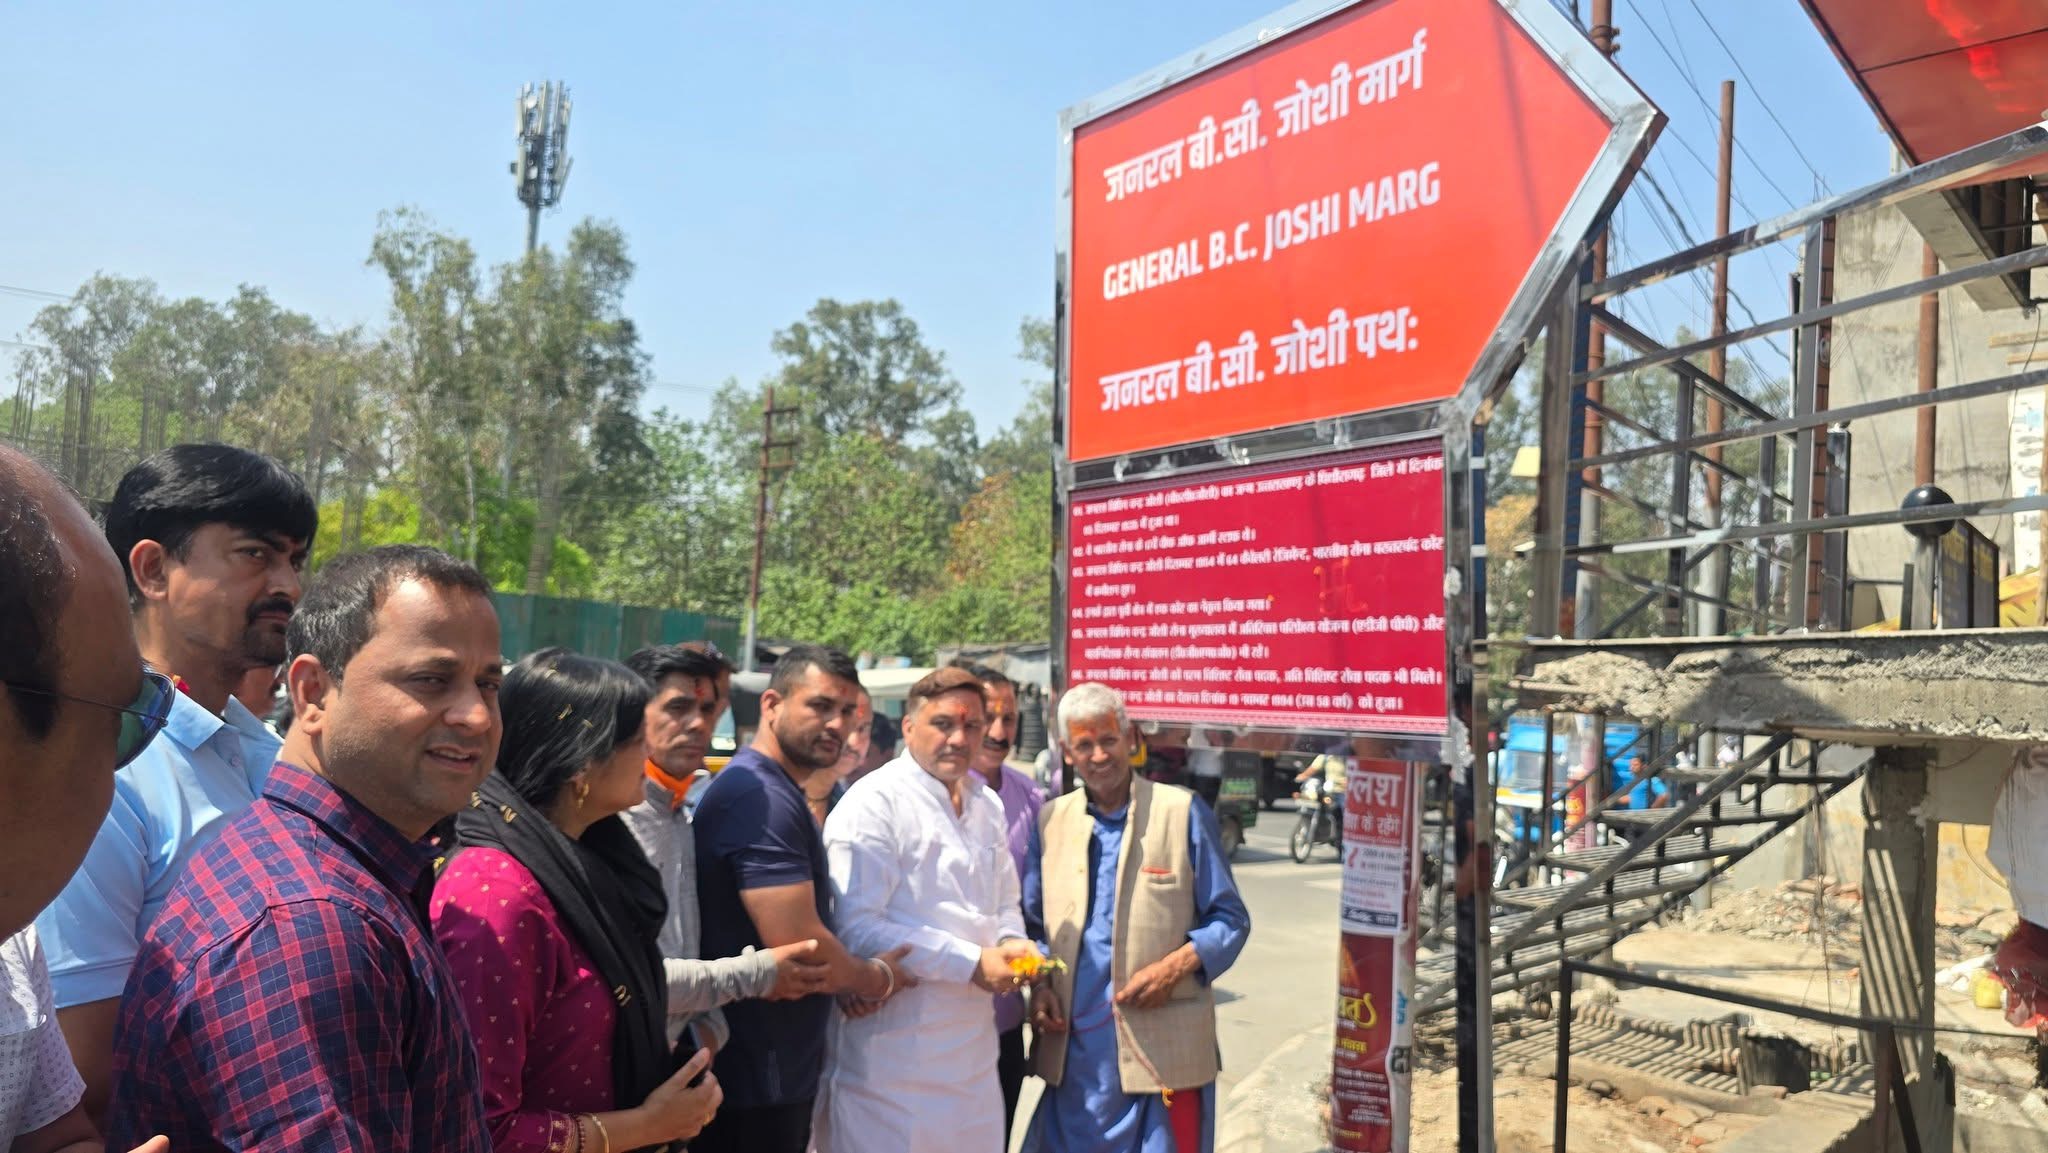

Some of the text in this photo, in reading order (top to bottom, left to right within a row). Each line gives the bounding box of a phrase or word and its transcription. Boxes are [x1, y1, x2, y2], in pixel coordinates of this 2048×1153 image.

[1104, 28, 1427, 202] जनरल बी.सी. जोशी मार्ग
[1104, 162, 1440, 300] GENERAL B.C. JOSHI MARG
[1100, 360, 1181, 410] जनरल
[1184, 331, 1264, 393] बी.सी.
[1271, 309, 1350, 374] जोशी
